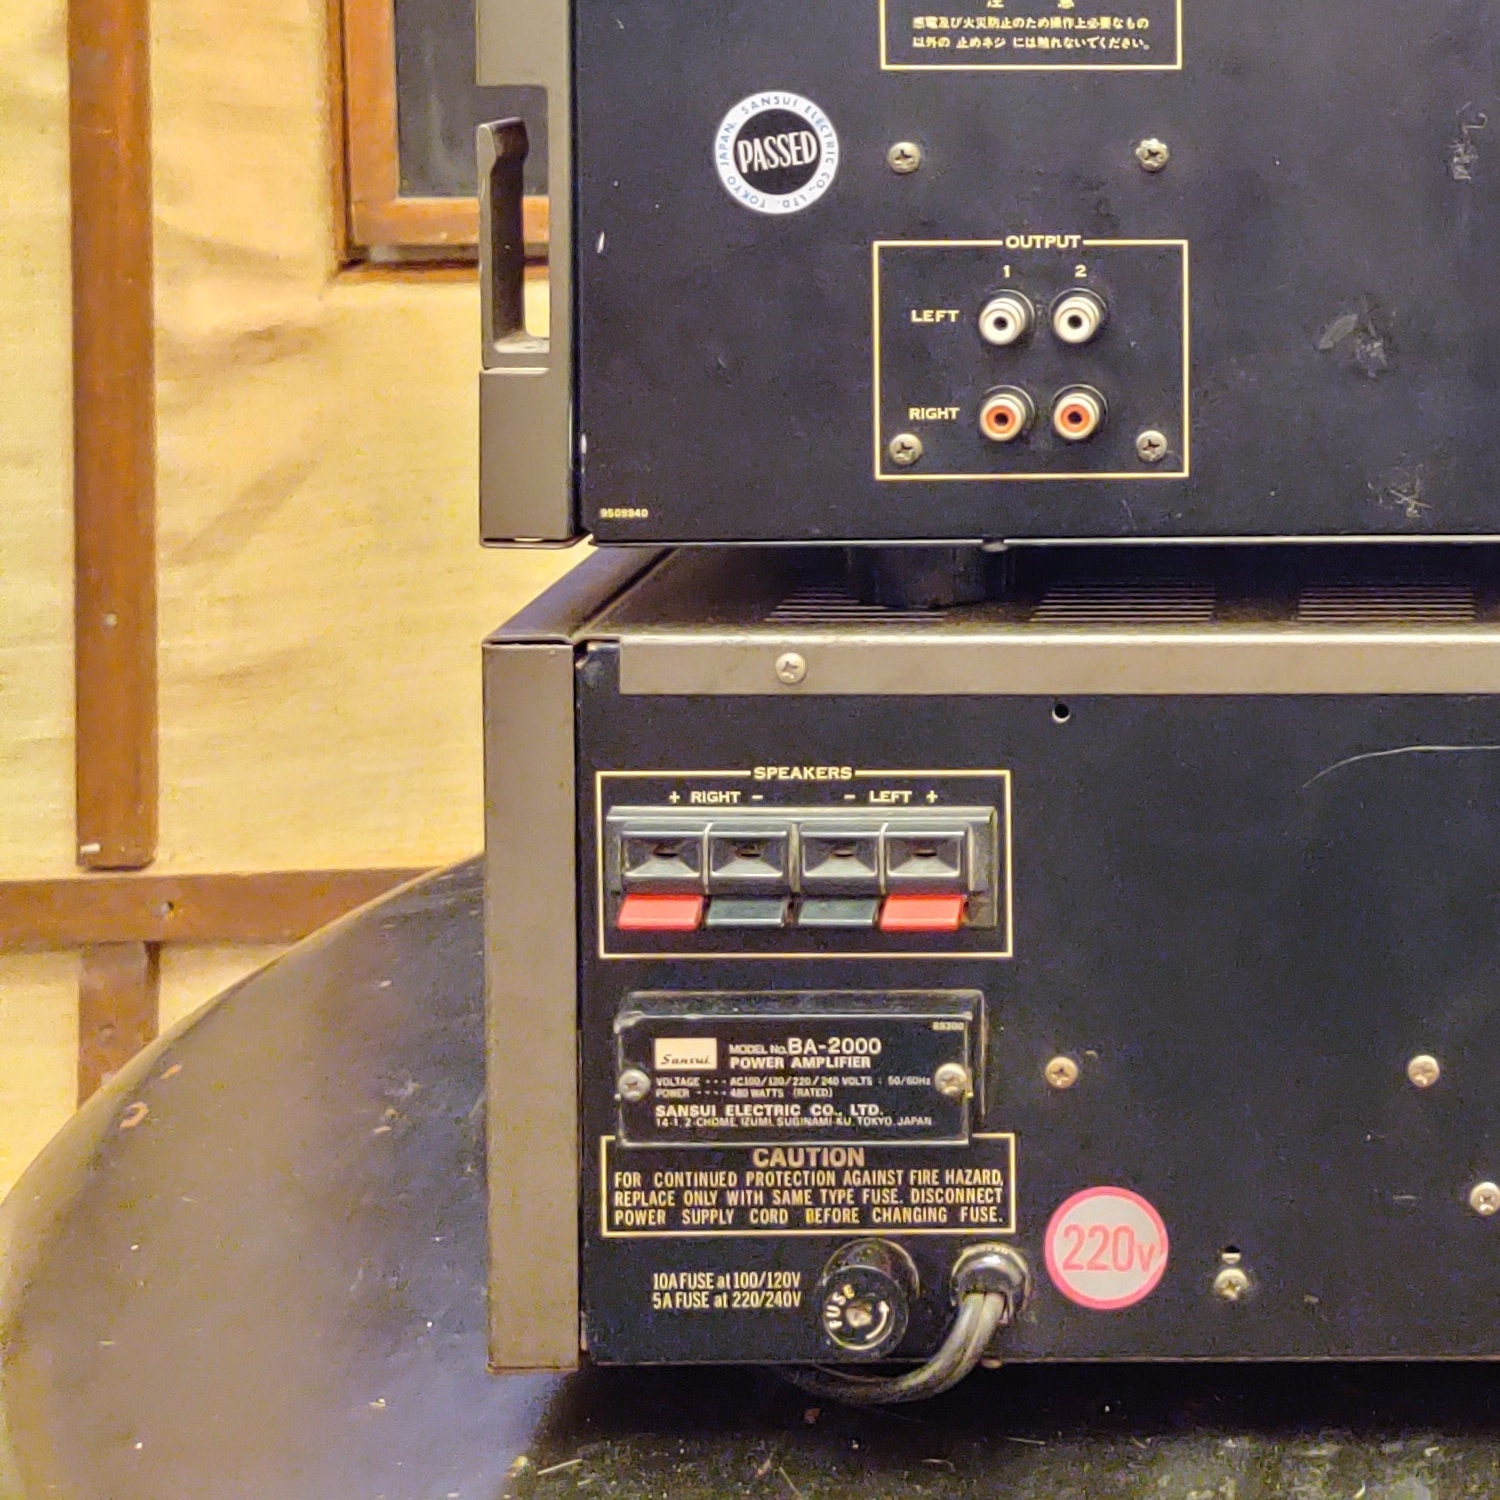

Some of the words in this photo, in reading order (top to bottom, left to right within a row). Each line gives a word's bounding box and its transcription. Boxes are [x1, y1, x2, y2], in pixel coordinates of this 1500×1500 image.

[741, 96, 798, 115] SANSUI
[737, 130, 818, 174] PASSED
[1005, 235, 1081, 249] OUTPUT
[1003, 265, 1011, 278] 1
[1075, 265, 1087, 278] 2
[911, 310, 960, 323] LEFT
[909, 407, 960, 420] RIGHT
[753, 767, 852, 780] SPEAKERS
[690, 791, 740, 803] RIGHT
[869, 791, 912, 803] LEFT
[660, 1053, 711, 1065] Sansui
[729, 1044, 768, 1055] MODEL
[787, 1037, 882, 1055] BA-2000
[730, 1057, 785, 1069] POWER
[791, 1056, 871, 1069] AMPLIFIER
[655, 1077, 700, 1087] VOLTAGE
[751, 1088, 784, 1098] WATTS
[656, 1104, 716, 1116] SANSUI
[725, 1104, 800, 1116] ELECTRIC
[810, 1104, 842, 1116] CO.,
[850, 1104, 884, 1116] LTD.
[752, 1147, 865, 1168] CAUTION
[615, 1170, 641, 1187] FOR
[654, 1170, 738, 1187] CONTINUED
[746, 1170, 835, 1187] PROTECTION
[843, 1170, 904, 1187] AGAINST
[910, 1170, 940, 1187] FIRE
[944, 1170, 1004, 1187] HAZARD,
[615, 1188, 674, 1206] REPLACE
[684, 1188, 718, 1206] ONLY
[726, 1188, 763, 1206] WITH
[773, 1188, 811, 1206] SAME
[819, 1188, 854, 1206] TYPE
[862, 1188, 903, 1206] FUSE.
[910, 1188, 1003, 1206] DISCONNECT
[615, 1207, 667, 1226] POWER
[681, 1207, 735, 1226] SUPPLY
[750, 1207, 789, 1226] CORD
[806, 1207, 860, 1226] BEFORE
[872, 1207, 947, 1226] CHANGING
[960, 1207, 1004, 1226] FUSE.
[652, 1272, 677, 1290] 10A
[679, 1272, 715, 1290] FUSE
[717, 1272, 730, 1290] at
[732, 1272, 801, 1290] 100/120V
[652, 1291, 678, 1308] 5A
[679, 1291, 713, 1308] FUSE
[716, 1291, 729, 1308] at
[732, 1291, 801, 1308] 220/240V
[826, 1284, 854, 1329] FUSE
